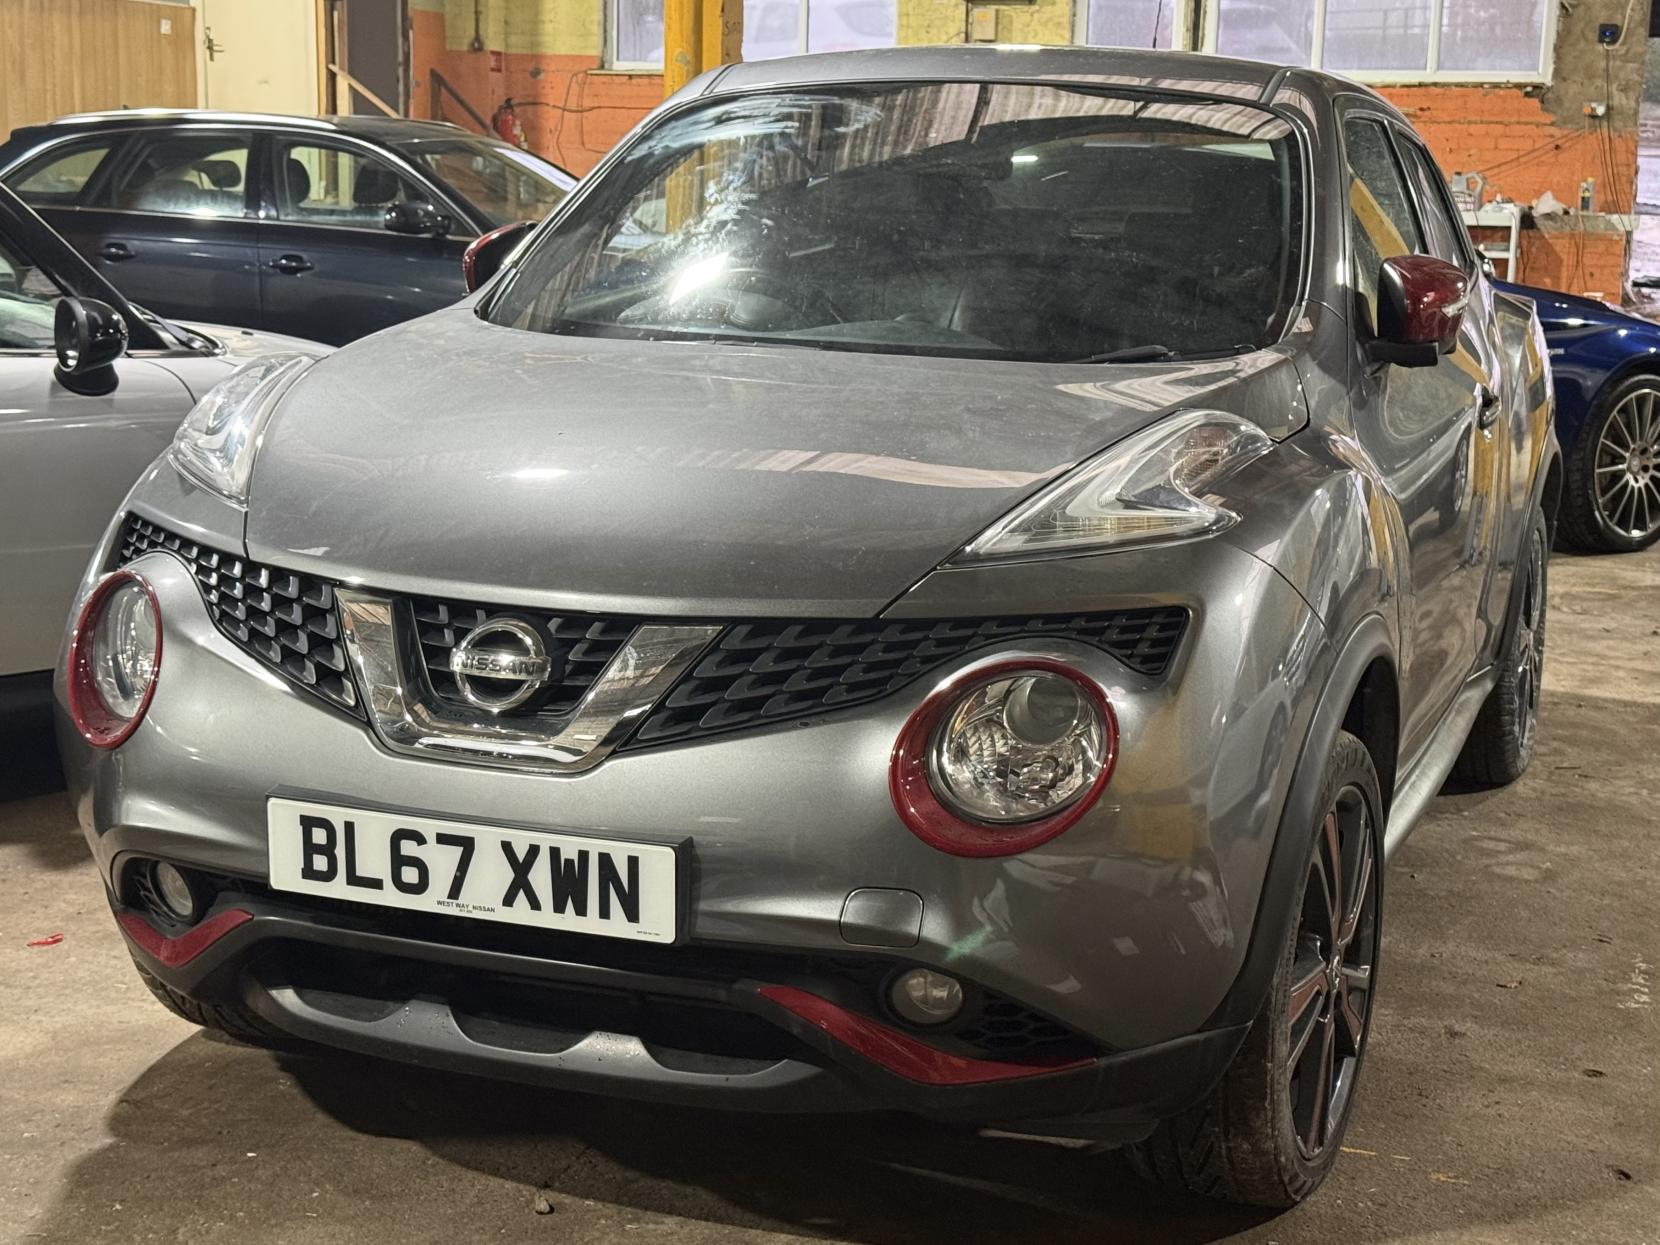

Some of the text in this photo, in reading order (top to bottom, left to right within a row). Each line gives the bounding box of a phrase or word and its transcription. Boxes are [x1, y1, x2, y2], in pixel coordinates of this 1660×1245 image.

[456, 655, 537, 676] NISSAN
[299, 814, 640, 924] BL67 XWN
[472, 904, 496, 913] NISSAN
